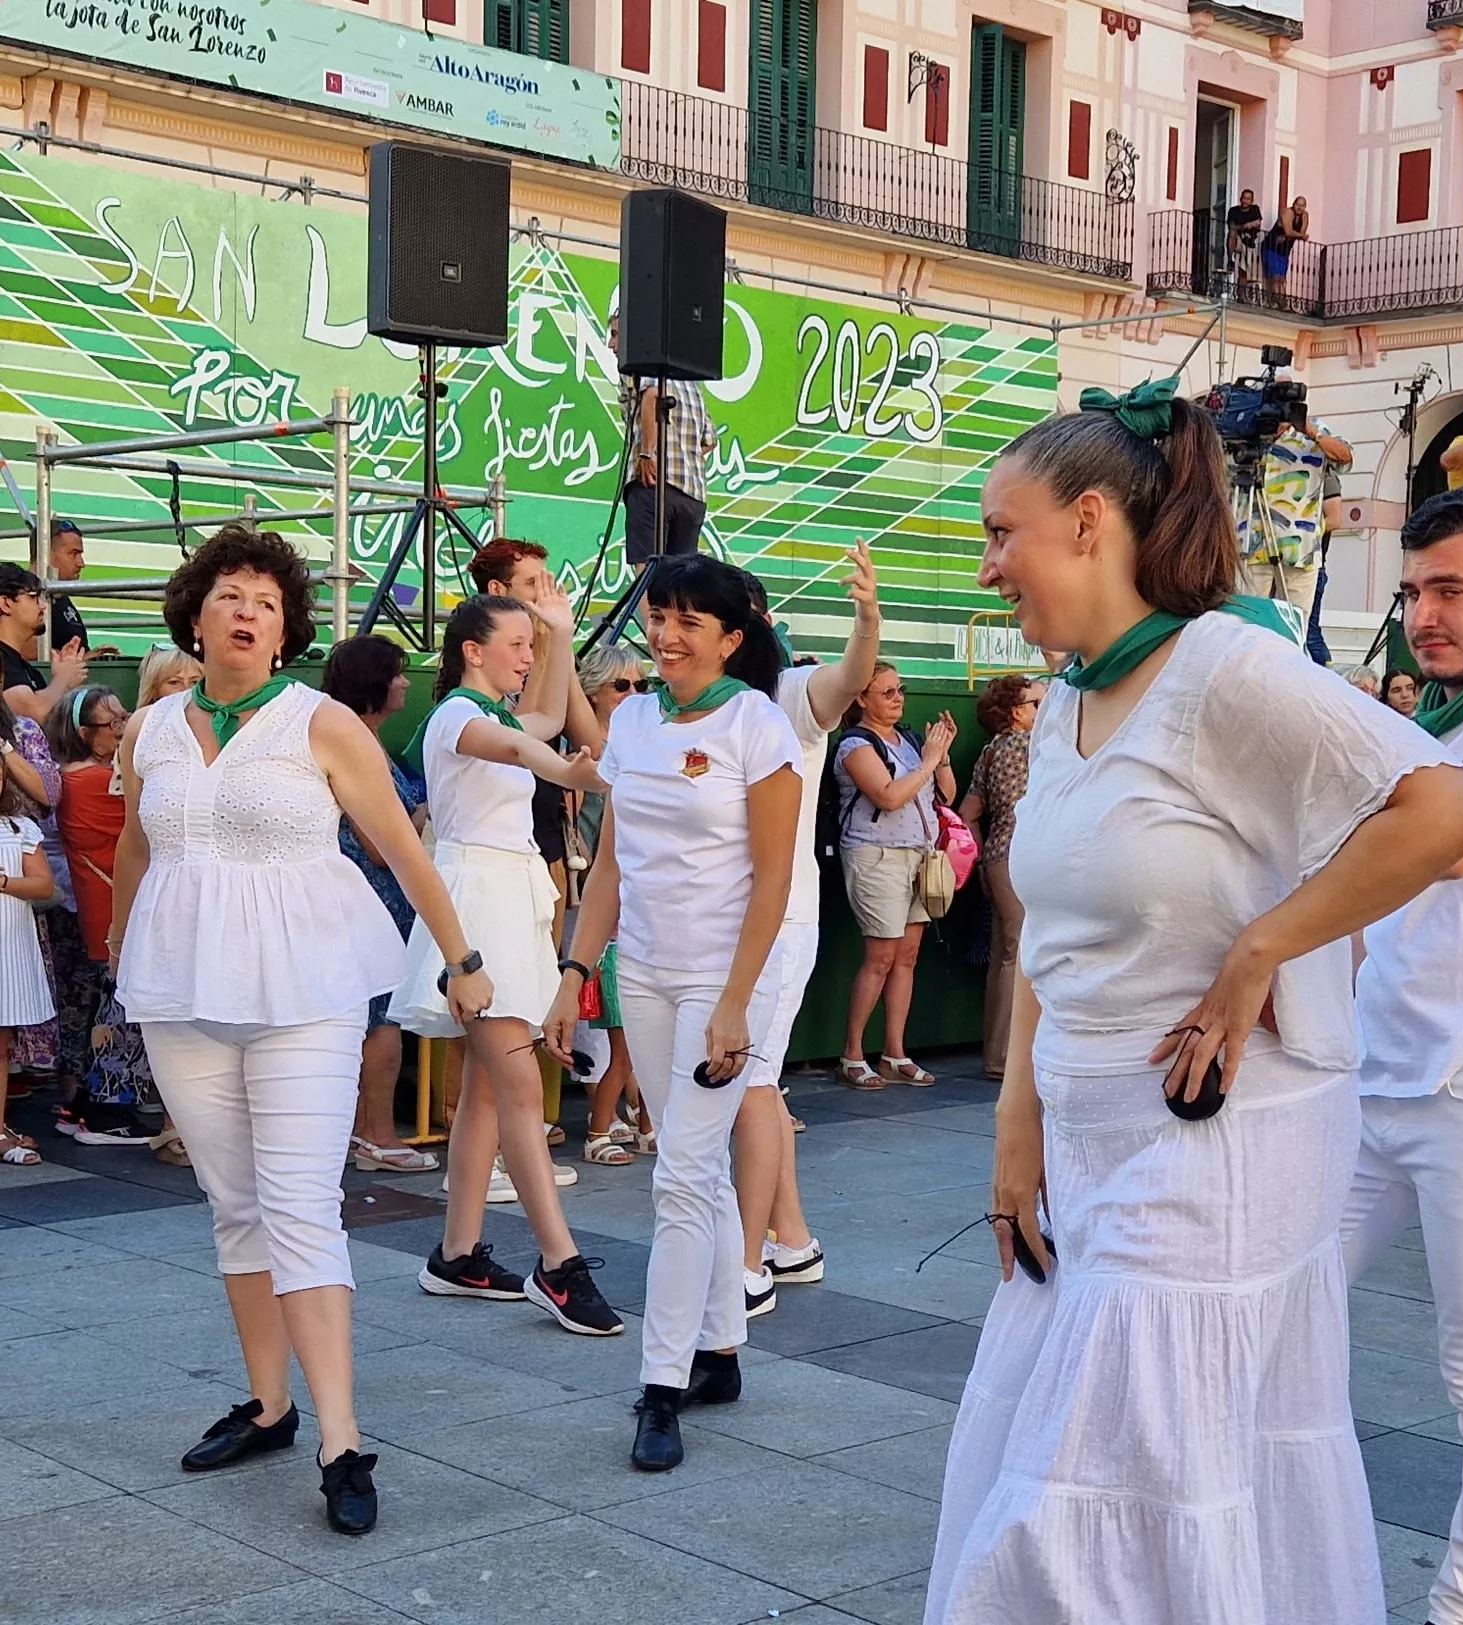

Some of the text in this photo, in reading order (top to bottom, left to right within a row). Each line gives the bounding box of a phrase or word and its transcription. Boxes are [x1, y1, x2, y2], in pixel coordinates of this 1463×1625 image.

[65, 3, 108, 28] jota
[115, 9, 141, 34] de
[146, 13, 184, 44] San
[188, 24, 267, 64] Lorenzo
[178, 1, 247, 35] nosotros
[430, 54, 540, 95] AltoAragón
[406, 94, 454, 117] AMBAR
[95, 197, 945, 443] SAN LENO 2023
[484, 386, 618, 486] fiestas
[704, 434, 783, 489] ás
